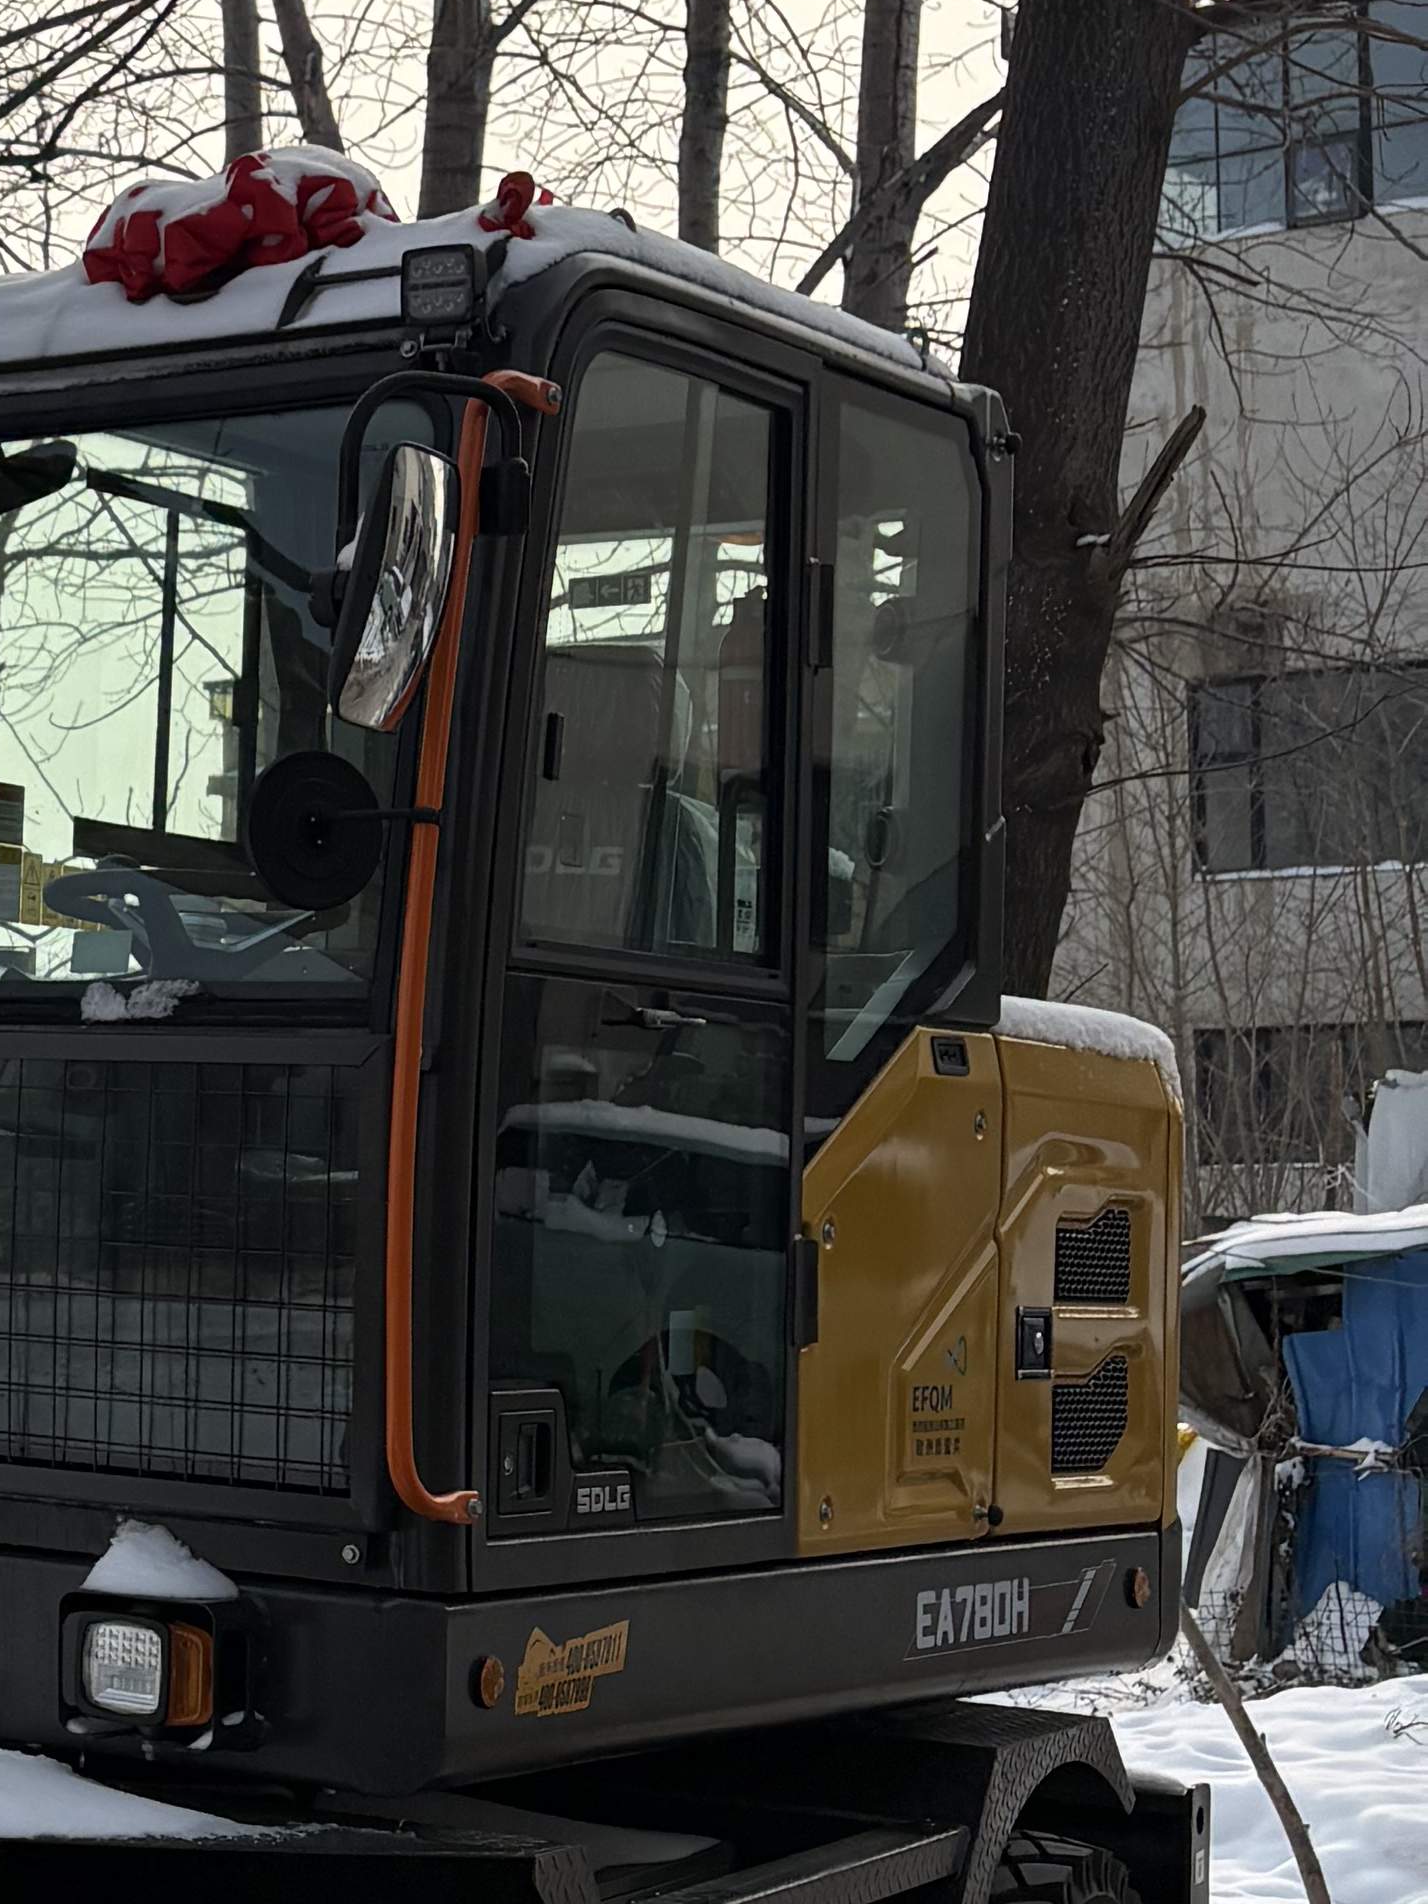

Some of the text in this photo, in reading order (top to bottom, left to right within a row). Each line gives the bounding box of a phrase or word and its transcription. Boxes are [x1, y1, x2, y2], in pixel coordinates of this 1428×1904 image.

[525, 844, 625, 875] DLG
[912, 1384, 953, 1413] EFQM
[576, 1484, 631, 1514] SDLG
[916, 1576, 1030, 1650] EA780H
